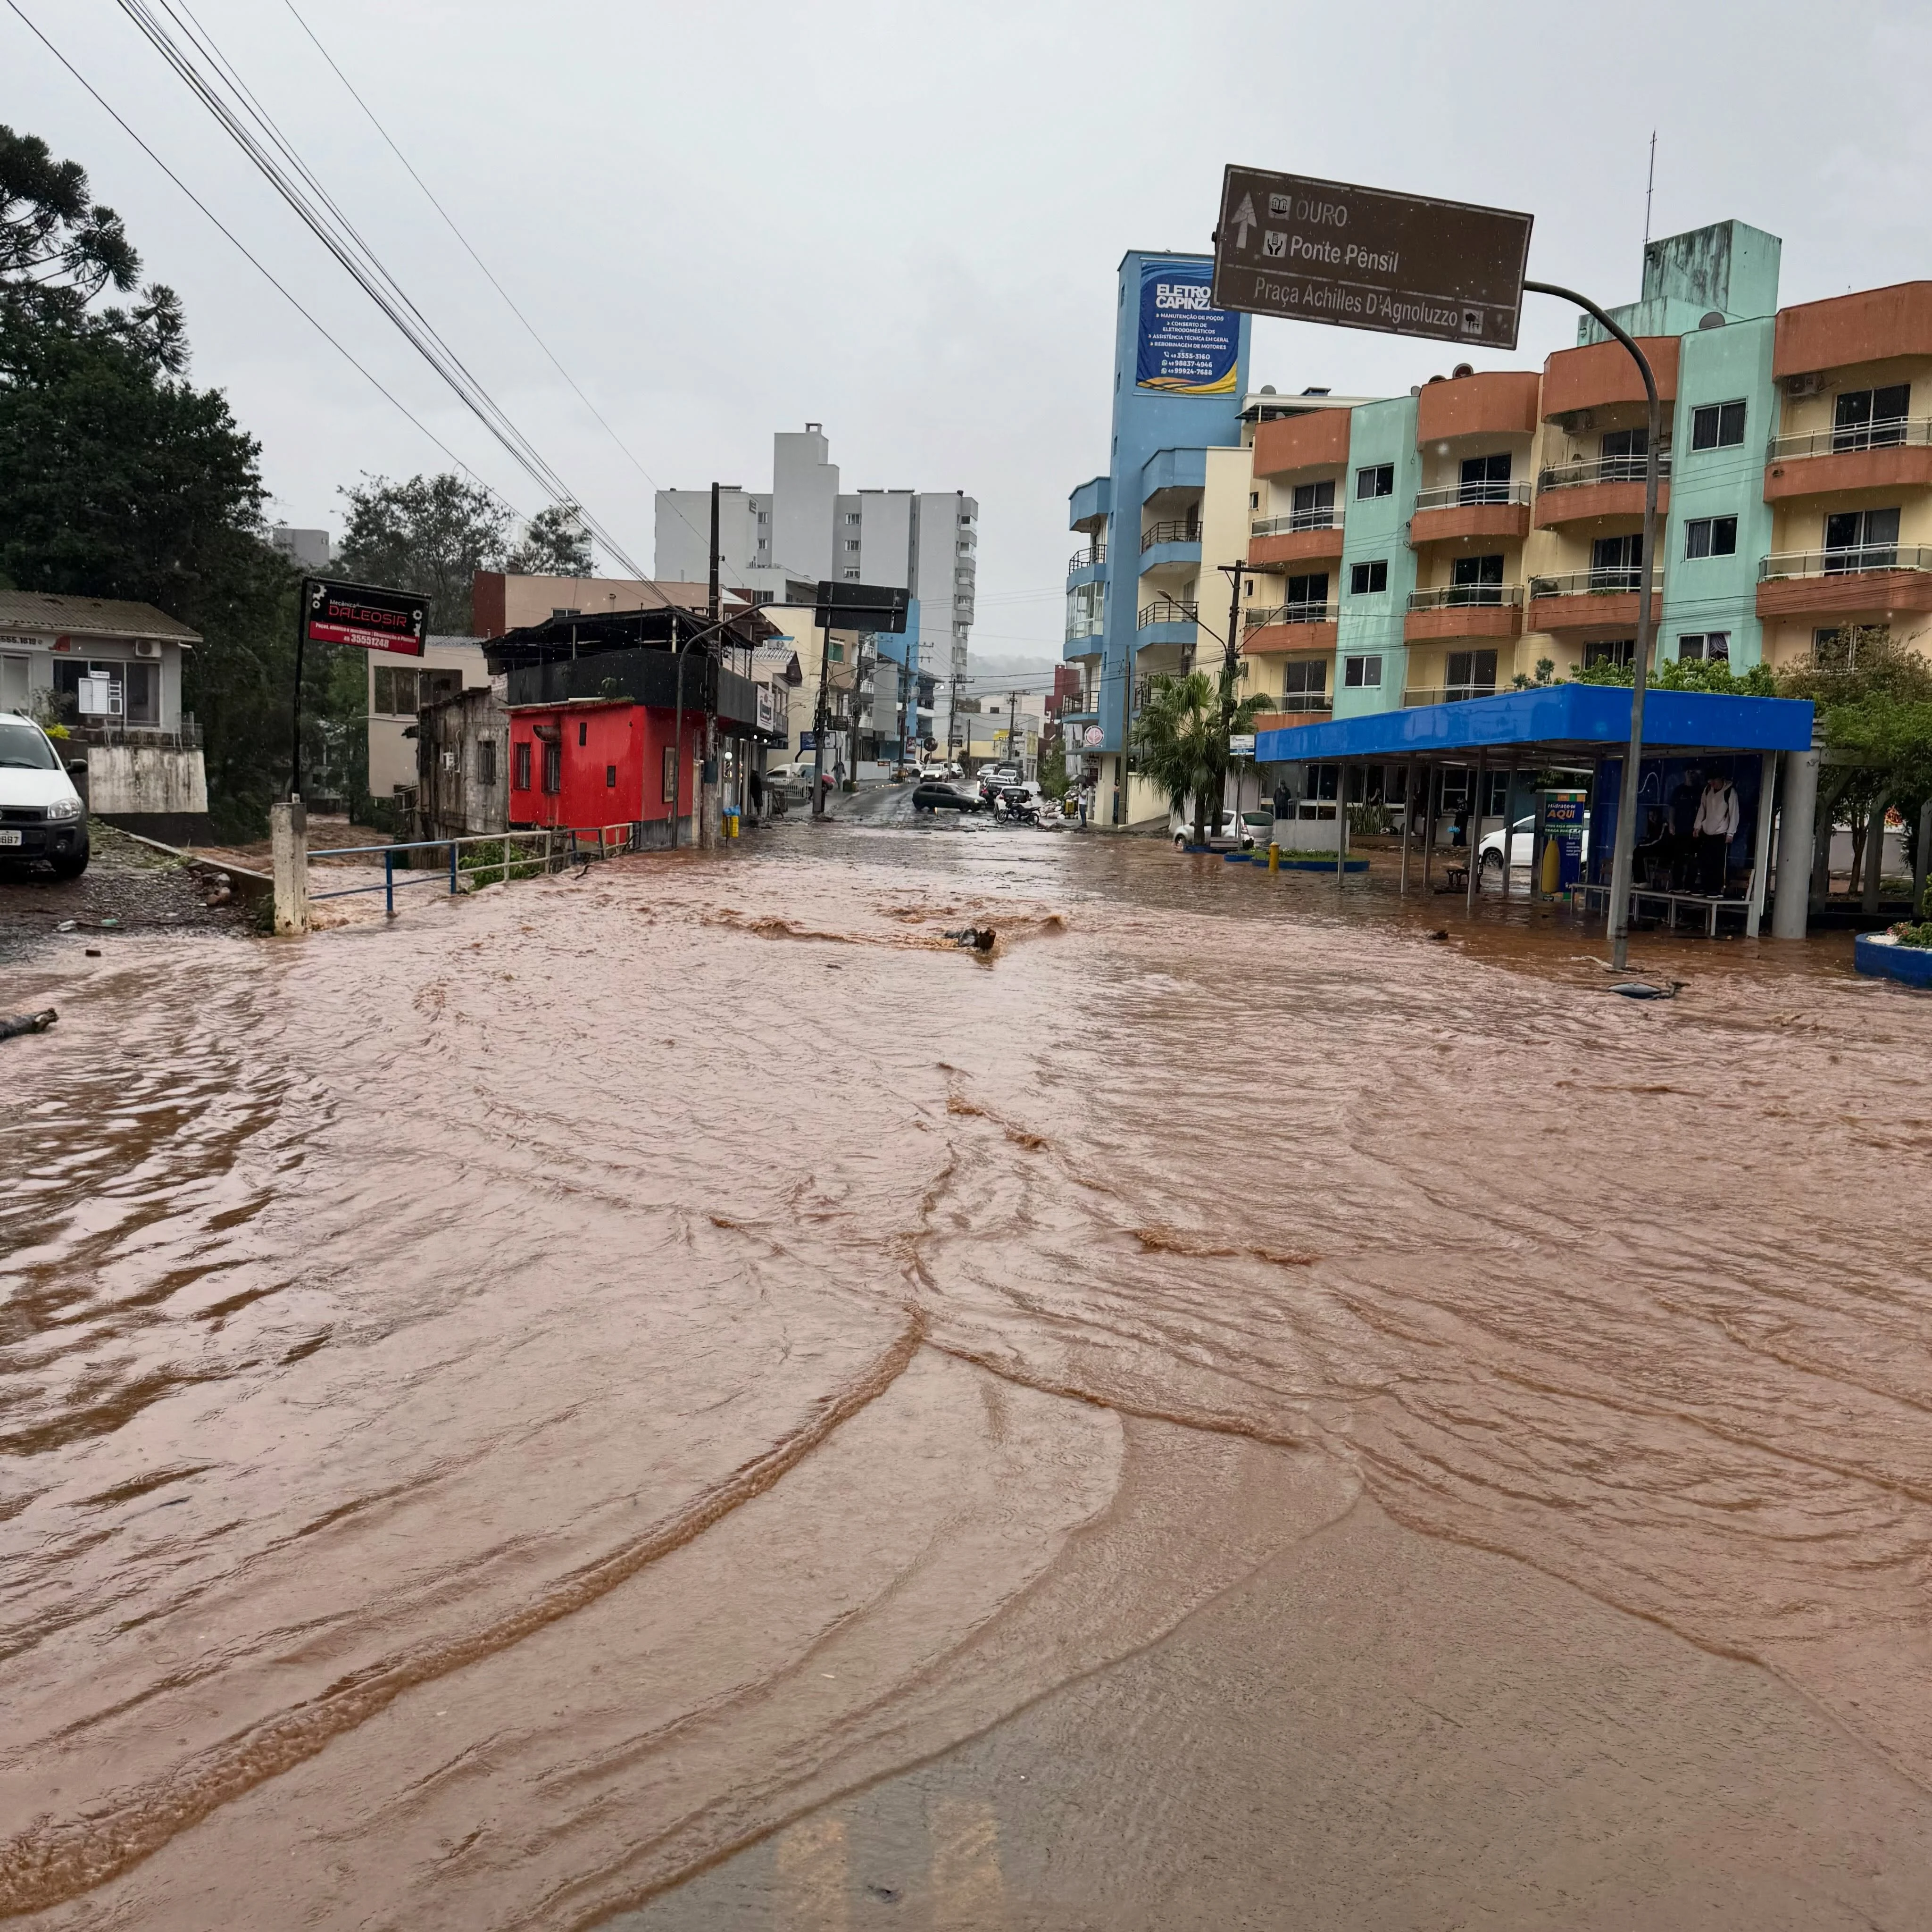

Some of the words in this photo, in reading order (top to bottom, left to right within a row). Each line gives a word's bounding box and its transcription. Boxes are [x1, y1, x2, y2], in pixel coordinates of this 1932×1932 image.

[1297, 200, 1348, 227] OURO
[1291, 235, 1341, 264] Ponte
[1345, 243, 1399, 273] Pênsil
[1157, 284, 1211, 299] ELETRO
[1255, 276, 1299, 307] Praça
[1303, 283, 1362, 313] Achilles
[1366, 293, 1458, 327] D'Agnoluzzo
[329, 605, 407, 627] DALEOSIR
[351, 633, 389, 648] 35551248
[1547, 809, 1575, 820] AQUI
